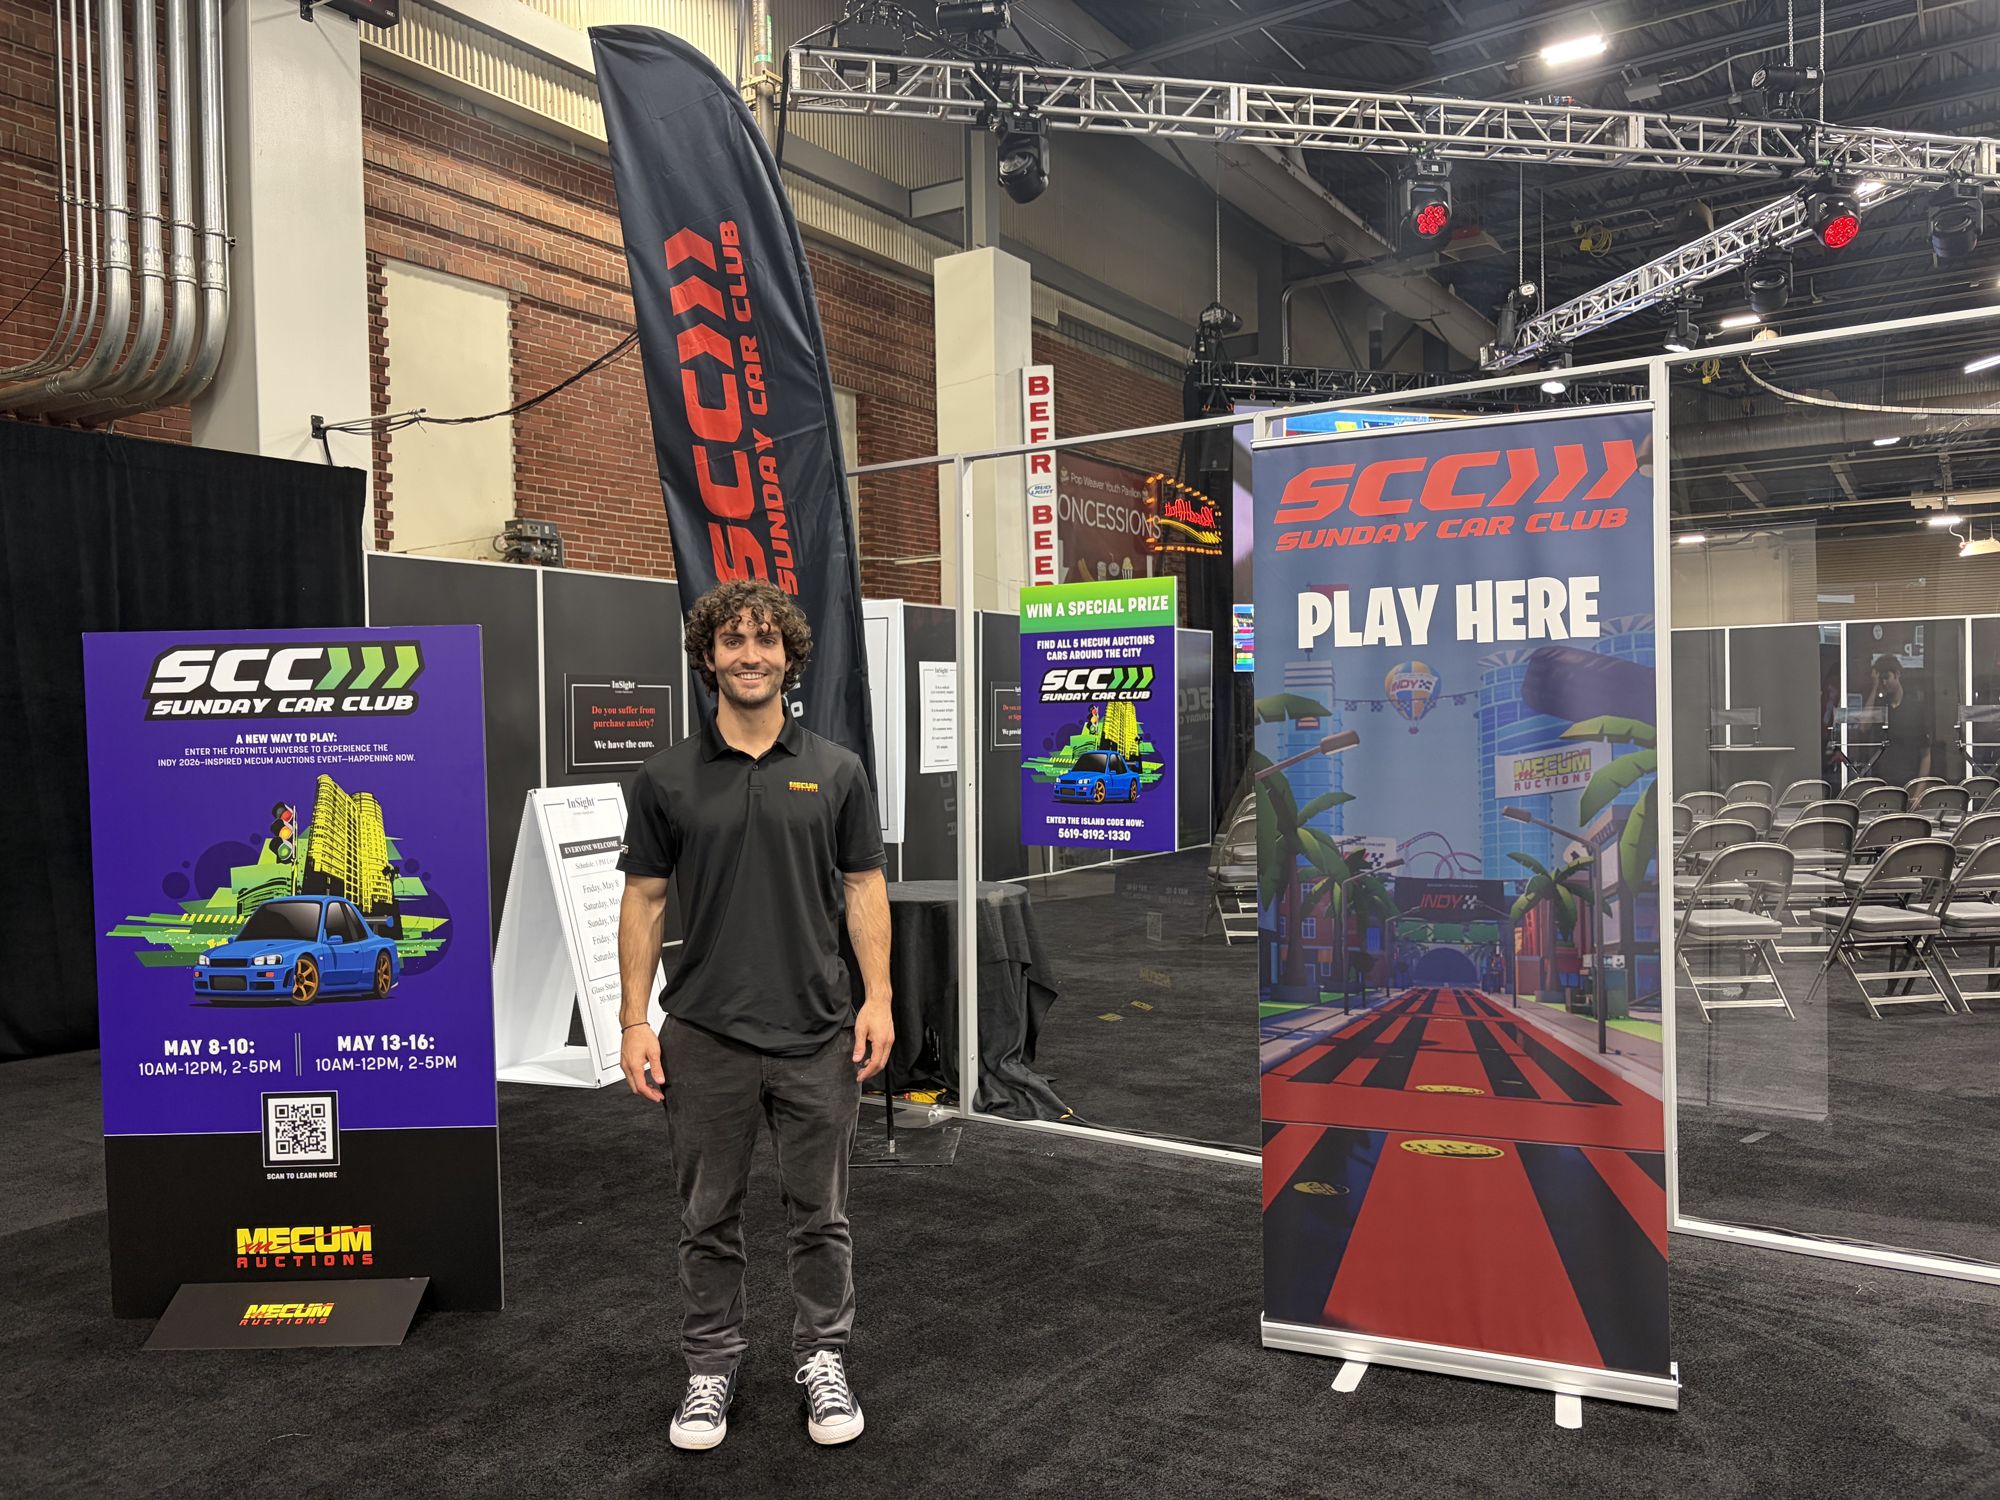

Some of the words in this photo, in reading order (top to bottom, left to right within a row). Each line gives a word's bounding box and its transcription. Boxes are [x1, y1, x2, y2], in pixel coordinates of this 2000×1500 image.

[719, 220, 753, 323] CLUB
[744, 335, 769, 417] CAR
[681, 368, 768, 583] SCC
[1030, 488, 1054, 496] LIGHT
[1070, 472, 1084, 486] Pop
[1083, 475, 1105, 490] Weaver
[1105, 481, 1121, 494] Youth
[1121, 485, 1141, 498] Pavilion
[1274, 451, 1501, 525] SCC
[753, 428, 799, 596] SUNDAY
[1058, 493, 1161, 539] ONCESSIONS
[1275, 521, 1428, 551] SUNDAY
[1436, 515, 1515, 539] CAR
[1524, 508, 1629, 533] CLUB
[1032, 505, 1055, 586] BEE
[1026, 603, 1052, 618] WIN
[1056, 603, 1065, 617] A
[1068, 598, 1124, 616] SPECIAL
[1128, 595, 1168, 612] PRIZE
[1297, 584, 1440, 650] PLAY
[1455, 575, 1600, 645] HERE
[1037, 640, 1055, 650] FIND
[1057, 639, 1071, 649] ALL
[1073, 638, 1078, 648] 5
[1080, 637, 1110, 648] MECUM
[1112, 635, 1155, 647] AUCTIONS
[1047, 650, 1068, 661] CARS
[1069, 649, 1103, 660] AROUND
[1105, 649, 1120, 658] THE
[1122, 647, 1141, 658] CITY
[150, 648, 324, 694] SCC
[1041, 668, 1112, 691] SCC
[612, 680, 635, 690] InSight
[1042, 692, 1089, 702] SUNDAY
[1091, 691, 1116, 700] CAR
[1118, 690, 1150, 700] CLUB
[152, 698, 271, 716] SUNDAY
[277, 696, 335, 713] CAR
[341, 695, 414, 712] CLUB
[592, 706, 602, 714] Do
[603, 707, 616, 716] you
[618, 705, 638, 714] suffer
[639, 705, 656, 714] from
[593, 719, 625, 730] purchase
[626, 718, 655, 729] anxiety?
[236, 735, 243, 744] A
[245, 734, 268, 744] NEW
[270, 733, 293, 743] WAY
[295, 733, 307, 743] TO
[310, 732, 338, 743] PLAY:
[594, 740, 606, 749] We
[608, 740, 625, 749] have
[626, 739, 637, 748] the
[184, 748, 210, 756] ENTER
[212, 747, 228, 756] THE
[230, 746, 267, 755] FORTNITE
[269, 745, 309, 755] UNIVERSE
[311, 745, 321, 753] TO
[323, 744, 371, 753] EXPERIENCE
[373, 743, 388, 752] THE
[158, 758, 177, 767] INDY
[244, 756, 273, 766] MECUM
[275, 755, 315, 765] AUCTIONS
[395, 753, 416, 762] NOW.
[1514, 748, 1592, 782] MECUM
[1514, 772, 1592, 791] AUCTIONS
[566, 797, 595, 809] InSight
[1046, 815, 1066, 825] ENTER
[1067, 816, 1080, 825] THE
[1081, 817, 1105, 826] ISLAND
[1106, 818, 1124, 826] CODE
[1125, 818, 1145, 827] NOW:
[1058, 828, 1131, 841] 5619-8192-1330
[564, 844, 592, 855] EVERYONE
[592, 840, 619, 851] WELCOME
[582, 884, 601, 894] Friday,
[602, 881, 614, 891] May
[1420, 894, 1463, 909] INDY
[588, 917, 609, 929] Sunday,
[164, 1040, 202, 1056] MAY
[208, 1038, 255, 1055] 8-10:
[337, 1036, 375, 1052] MAY
[381, 1034, 435, 1051] 13-16:
[139, 1061, 227, 1077] 10AM-12PM,
[232, 1060, 281, 1074] 2-5PM
[315, 1057, 404, 1072] 10AM-12PM,
[408, 1055, 457, 1070] 2-5PM
[286, 1172, 295, 1180] TO
[319, 1171, 338, 1179] MORE
[236, 1225, 372, 1255] MECUM
[236, 1254, 373, 1269] AUCTIONS
[244, 1302, 335, 1319] MECUM
[239, 1317, 328, 1326] AUCTIONS
